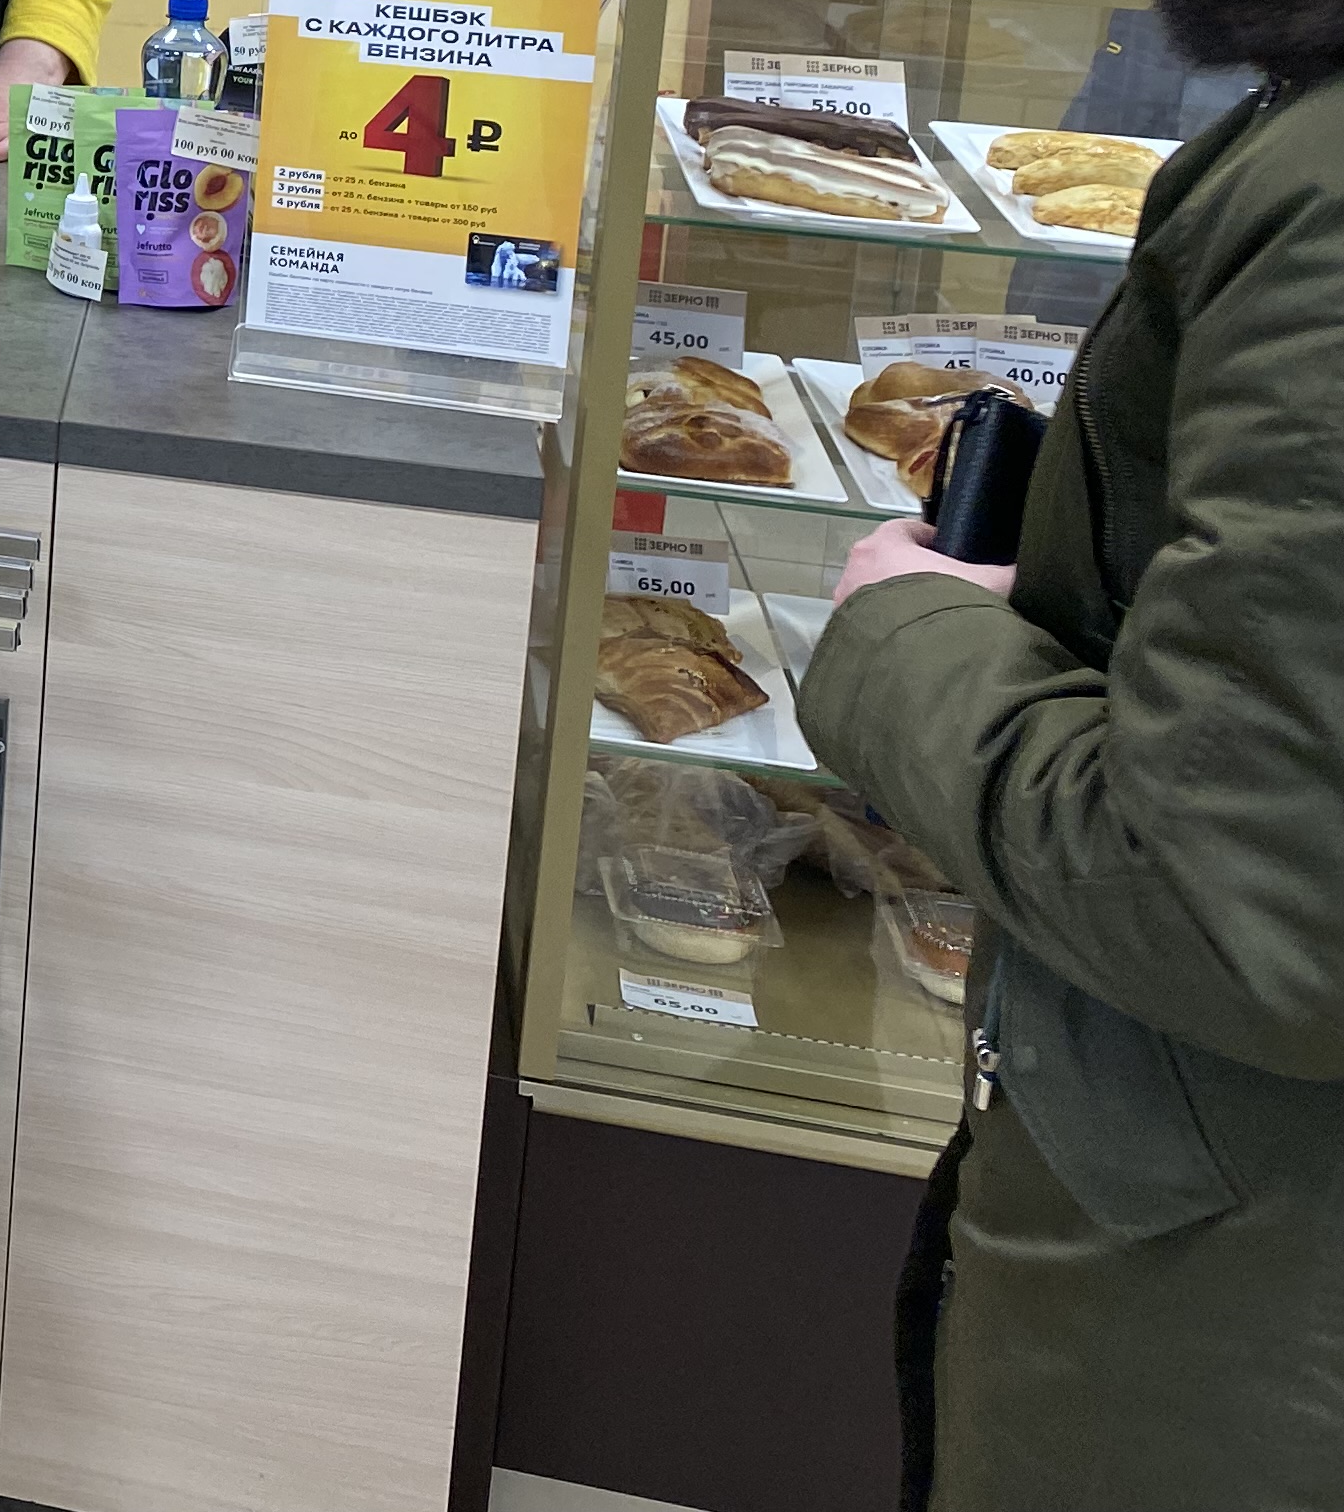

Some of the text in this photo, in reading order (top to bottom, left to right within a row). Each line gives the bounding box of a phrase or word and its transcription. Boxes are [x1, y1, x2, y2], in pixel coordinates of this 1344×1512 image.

[375, 4, 486, 26] КЕШБЭК
[305, 18, 554, 53] С КАЖДОГО ЛИТРА
[367, 43, 493, 68] БЕНЗИНА
[823, 63, 862, 76] ЗЕРНО
[812, 99, 872, 116] 55,00
[339, 130, 357, 142] до
[363, 74, 456, 178] 4
[174, 138, 259, 164] 100 руб 00 коп
[137, 160, 192, 189] Glo
[279, 168, 406, 189] 2 рубля бензина
[277, 182, 322, 196] 3 рубля
[277, 197, 321, 211] 4 рубля
[137, 241, 172, 251] Jefrutto
[271, 245, 345, 263] СЕМЕЙНАЯ
[269, 257, 340, 274] КОМАНДА
[663, 294, 703, 307] ЗЕРНО
[649, 331, 709, 349] 45,00
[1006, 368, 1068, 386] 40,00
[637, 577, 695, 596] 65,00
